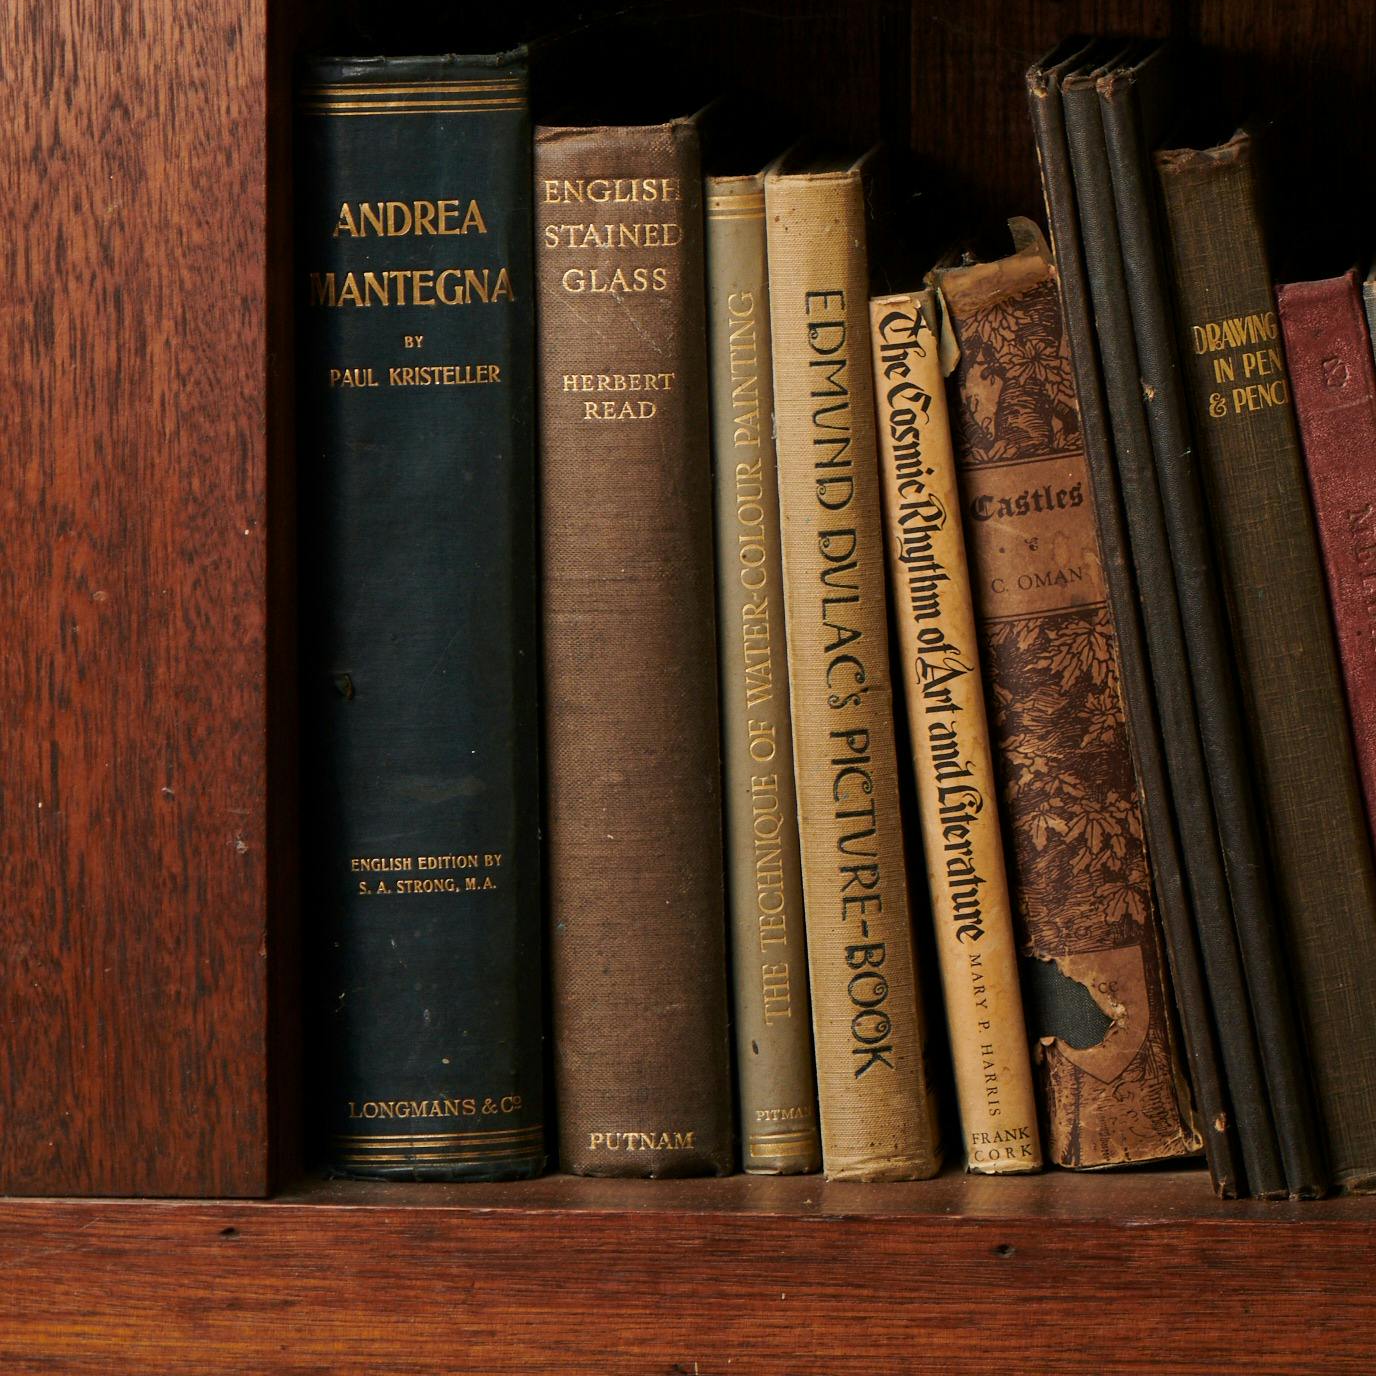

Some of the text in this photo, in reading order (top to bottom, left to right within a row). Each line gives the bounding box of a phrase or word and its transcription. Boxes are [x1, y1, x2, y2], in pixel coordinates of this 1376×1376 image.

[333, 200, 487, 238] ANDREA
[545, 223, 683, 248] STAINED
[310, 267, 515, 306] MANTEGNA
[562, 268, 667, 293] GLASS
[404, 336, 423, 348] BY
[876, 310, 927, 380] The
[330, 365, 500, 387] PAUL KRISTELLER
[1214, 349, 1281, 383] IN PEN
[563, 373, 675, 390] HERBERT
[584, 401, 656, 419] READ
[885, 382, 937, 501] Cosmic
[970, 482, 1084, 523] Castles
[897, 493, 951, 622] Rhythm
[1018, 567, 1083, 591] OMAN
[727, 292, 791, 1024] THE TECHNIQUE OF WATER-COLOUR PAINTING
[926, 721, 969, 782] and
[352, 856, 478, 872] ENGLISH EDITION
[935, 785, 984, 943] Literature
[967, 954, 1001, 1116] MARY HARRIS
[589, 1132, 694, 1151] PUTNAM
[971, 1127, 1030, 1145] FRANK
[974, 1145, 1032, 1161] CORK
